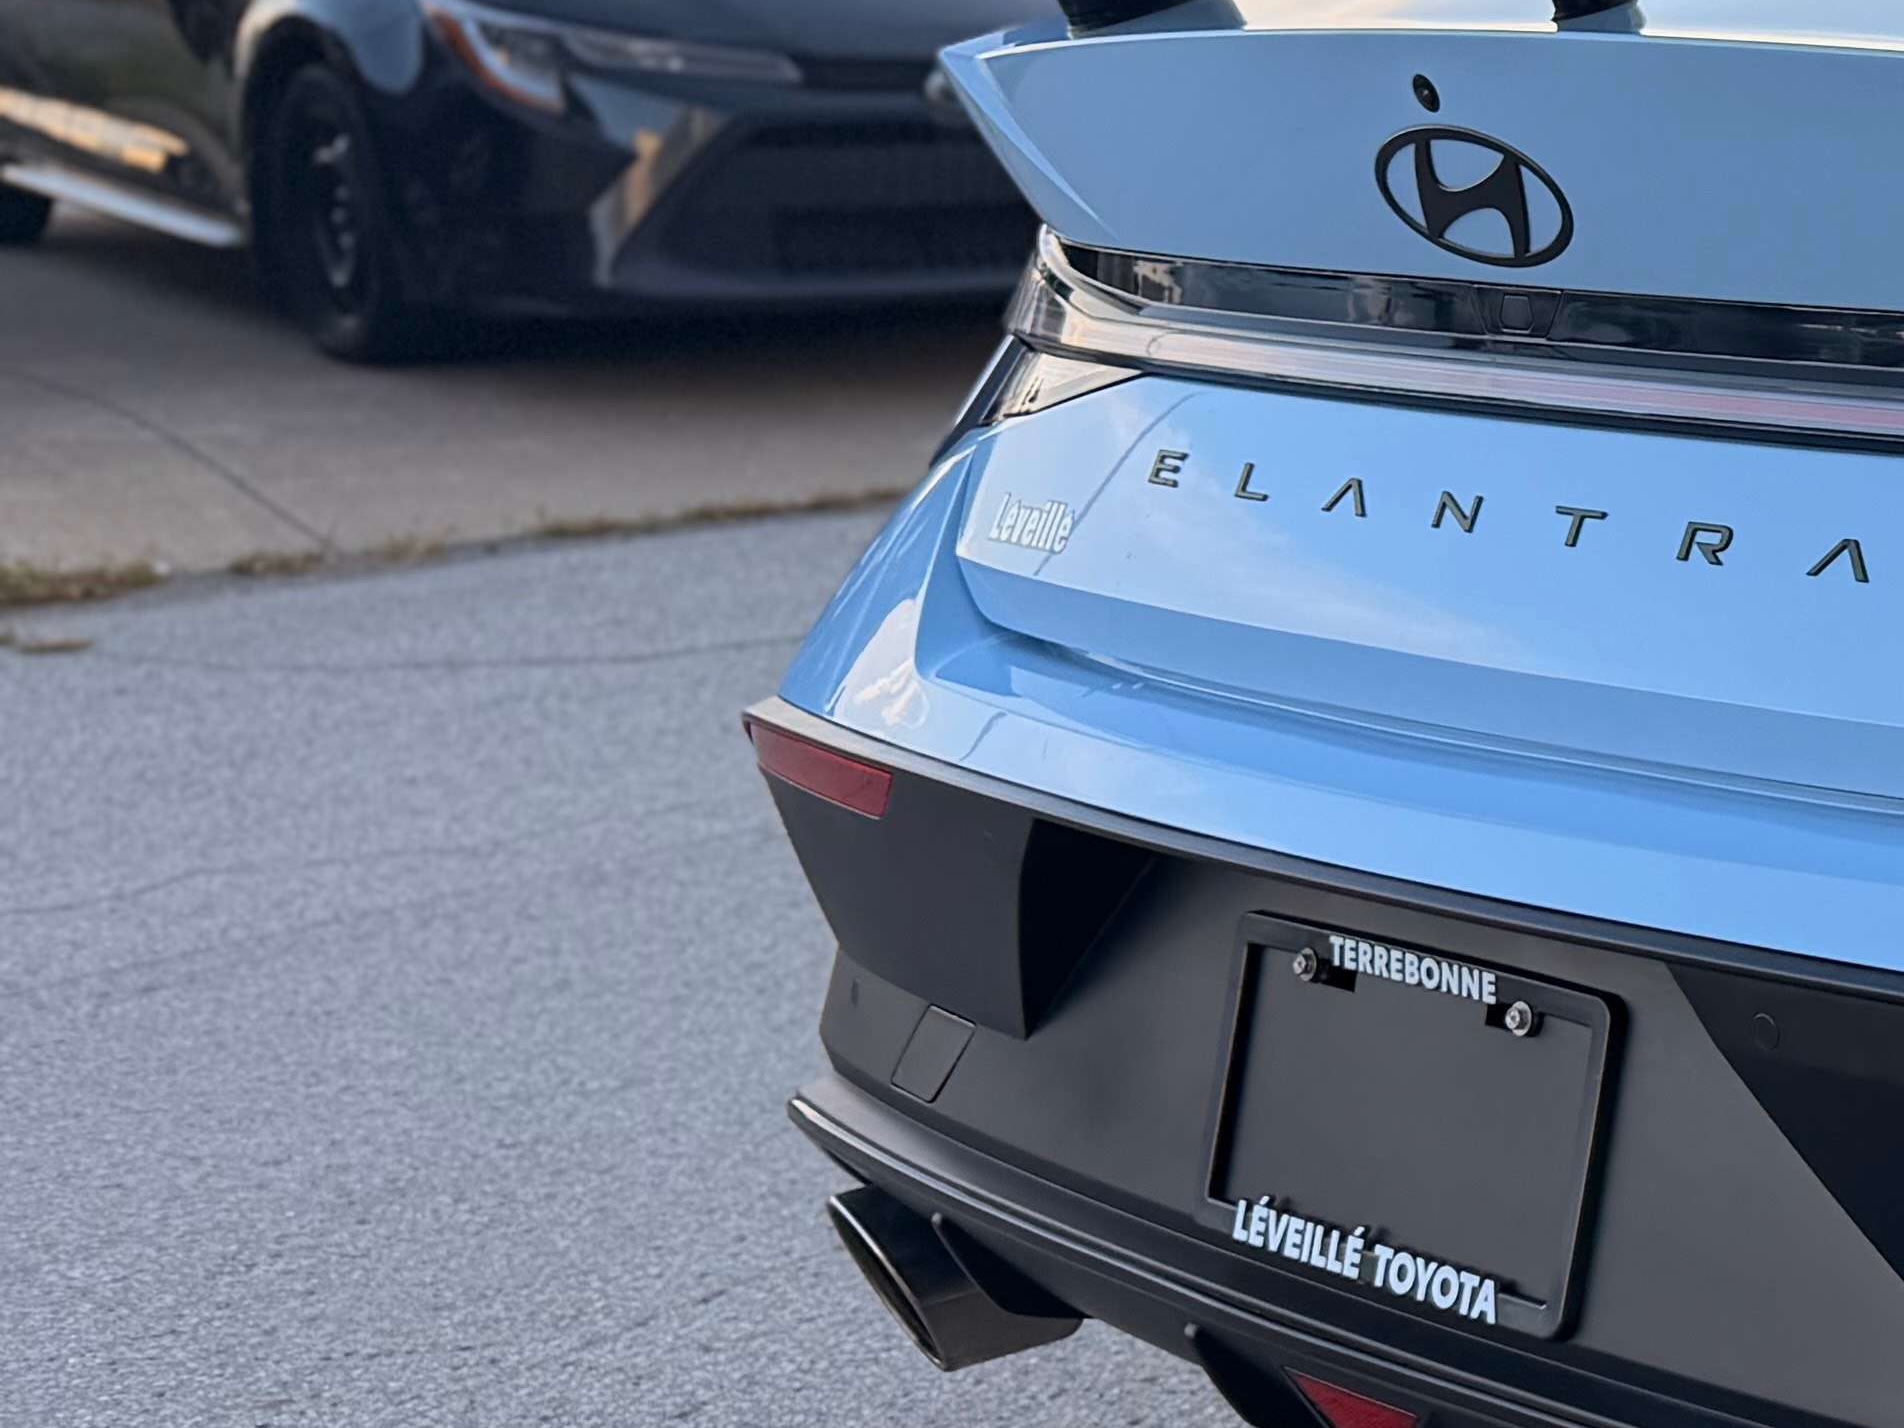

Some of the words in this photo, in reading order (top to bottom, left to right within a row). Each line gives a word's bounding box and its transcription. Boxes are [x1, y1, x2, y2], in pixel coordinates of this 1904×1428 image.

[1148, 448, 1870, 583] ELANTRA
[1329, 935, 1497, 1005] TERREBONNE
[1232, 1195, 1365, 1280] LÉVEILLÉ
[1373, 1243, 1496, 1325] TOYOTA
